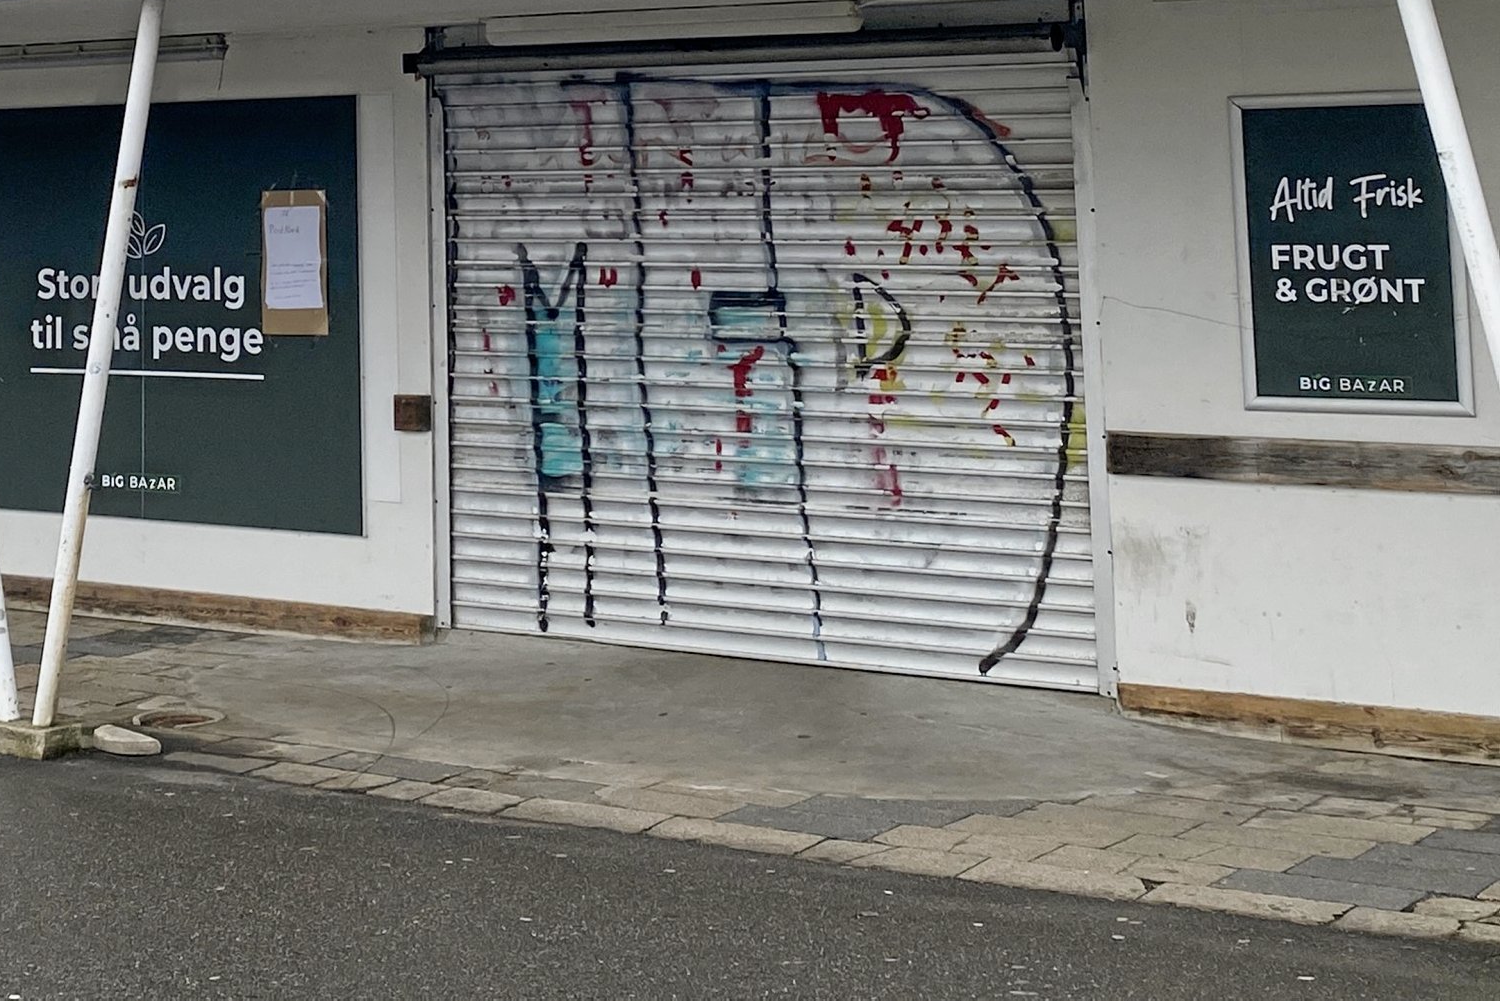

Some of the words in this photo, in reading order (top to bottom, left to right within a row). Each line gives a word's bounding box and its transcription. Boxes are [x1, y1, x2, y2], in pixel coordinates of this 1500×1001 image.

[1269, 176, 1334, 223] Altid
[1349, 173, 1424, 219] Frisk
[1270, 244, 1390, 271] FRUGT
[128, 265, 246, 310] udvalg
[1275, 277, 1298, 303] &
[1304, 275, 1426, 305] GRØNT
[30, 314, 63, 350] til
[152, 324, 264, 363] penge
[1339, 377, 1405, 393] BAZAR
[129, 475, 176, 491] BAZAR
